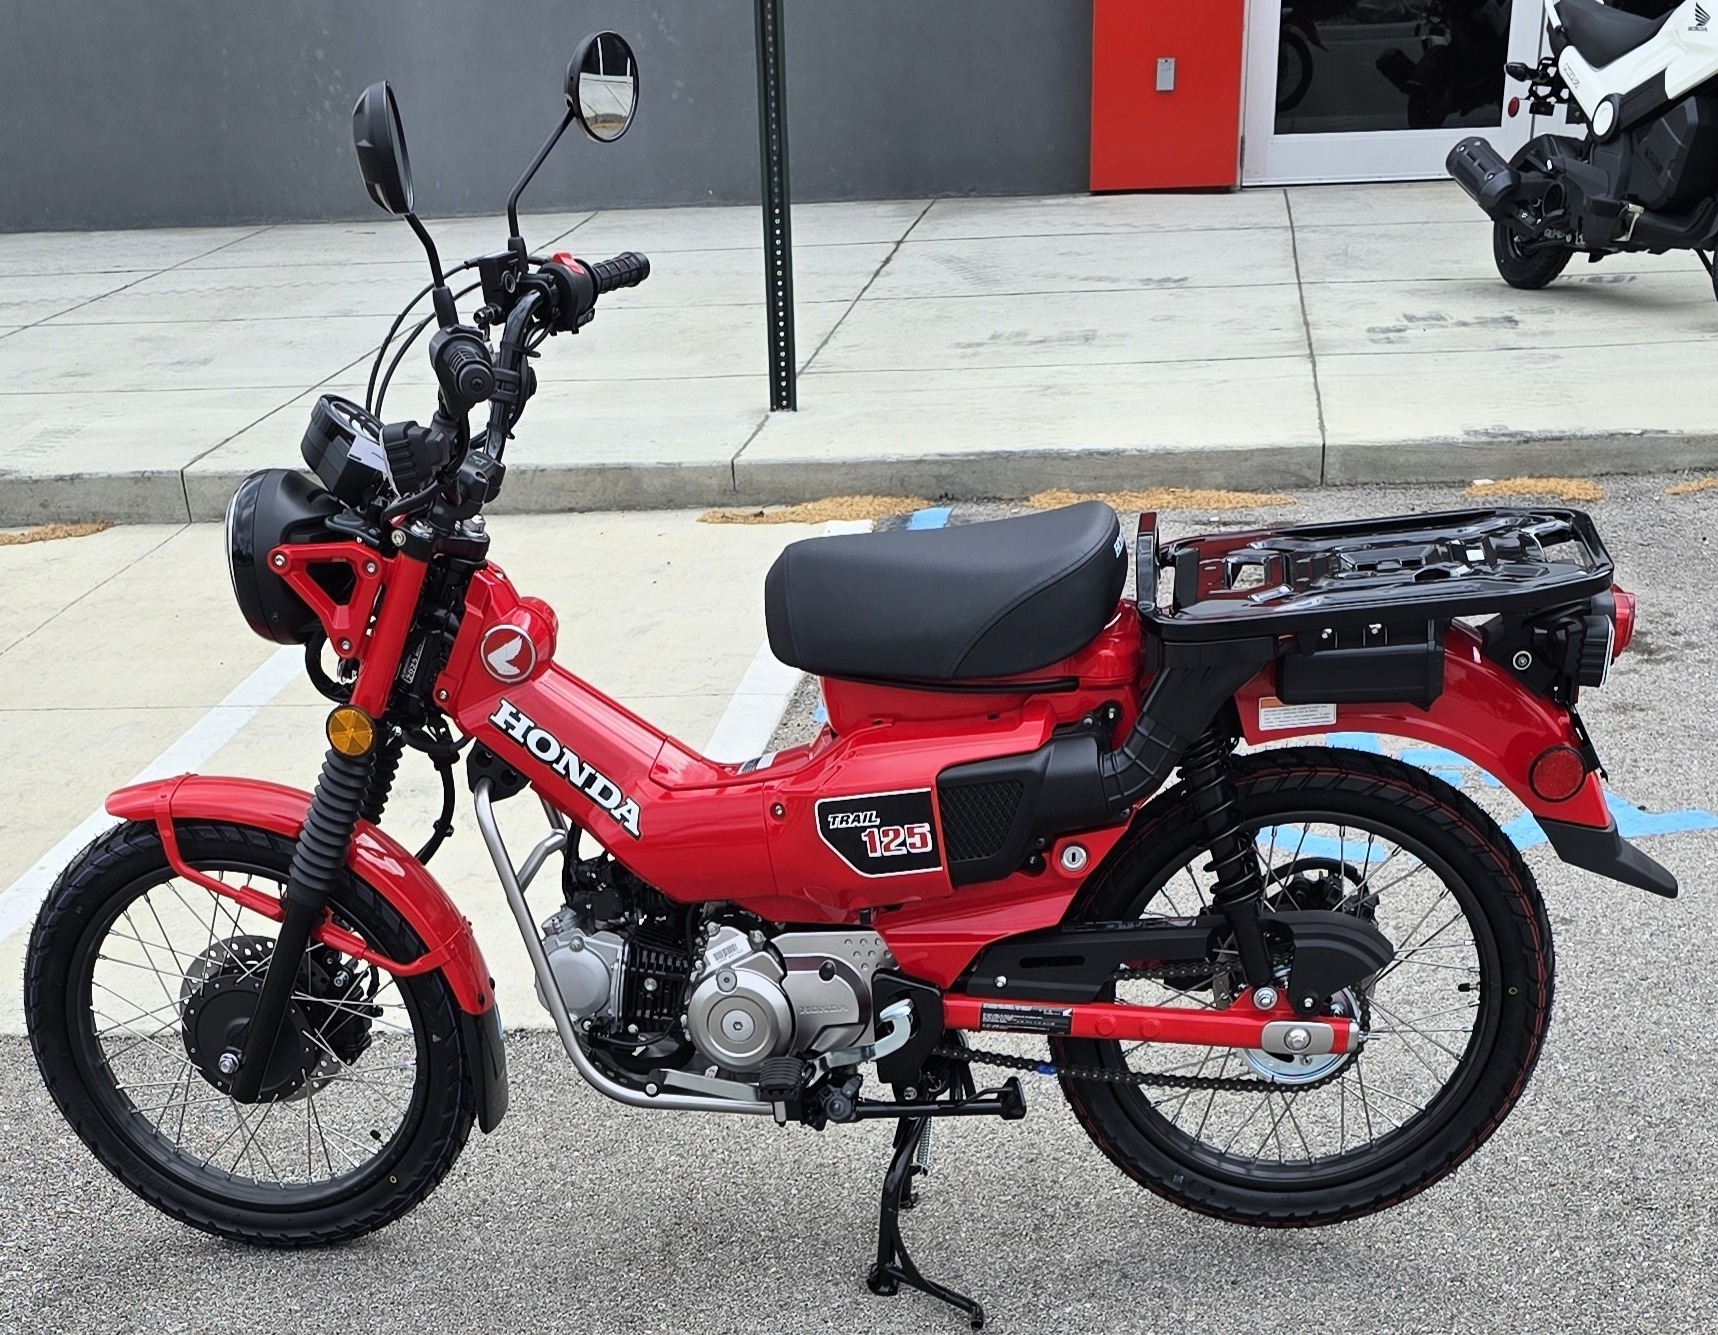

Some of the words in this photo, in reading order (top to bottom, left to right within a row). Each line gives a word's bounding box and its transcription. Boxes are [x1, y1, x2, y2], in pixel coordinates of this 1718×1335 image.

[489, 698, 643, 841] HONDA
[827, 810, 881, 830] TRAIL
[861, 823, 933, 857] 125
[798, 1004, 849, 1015] HONDA
